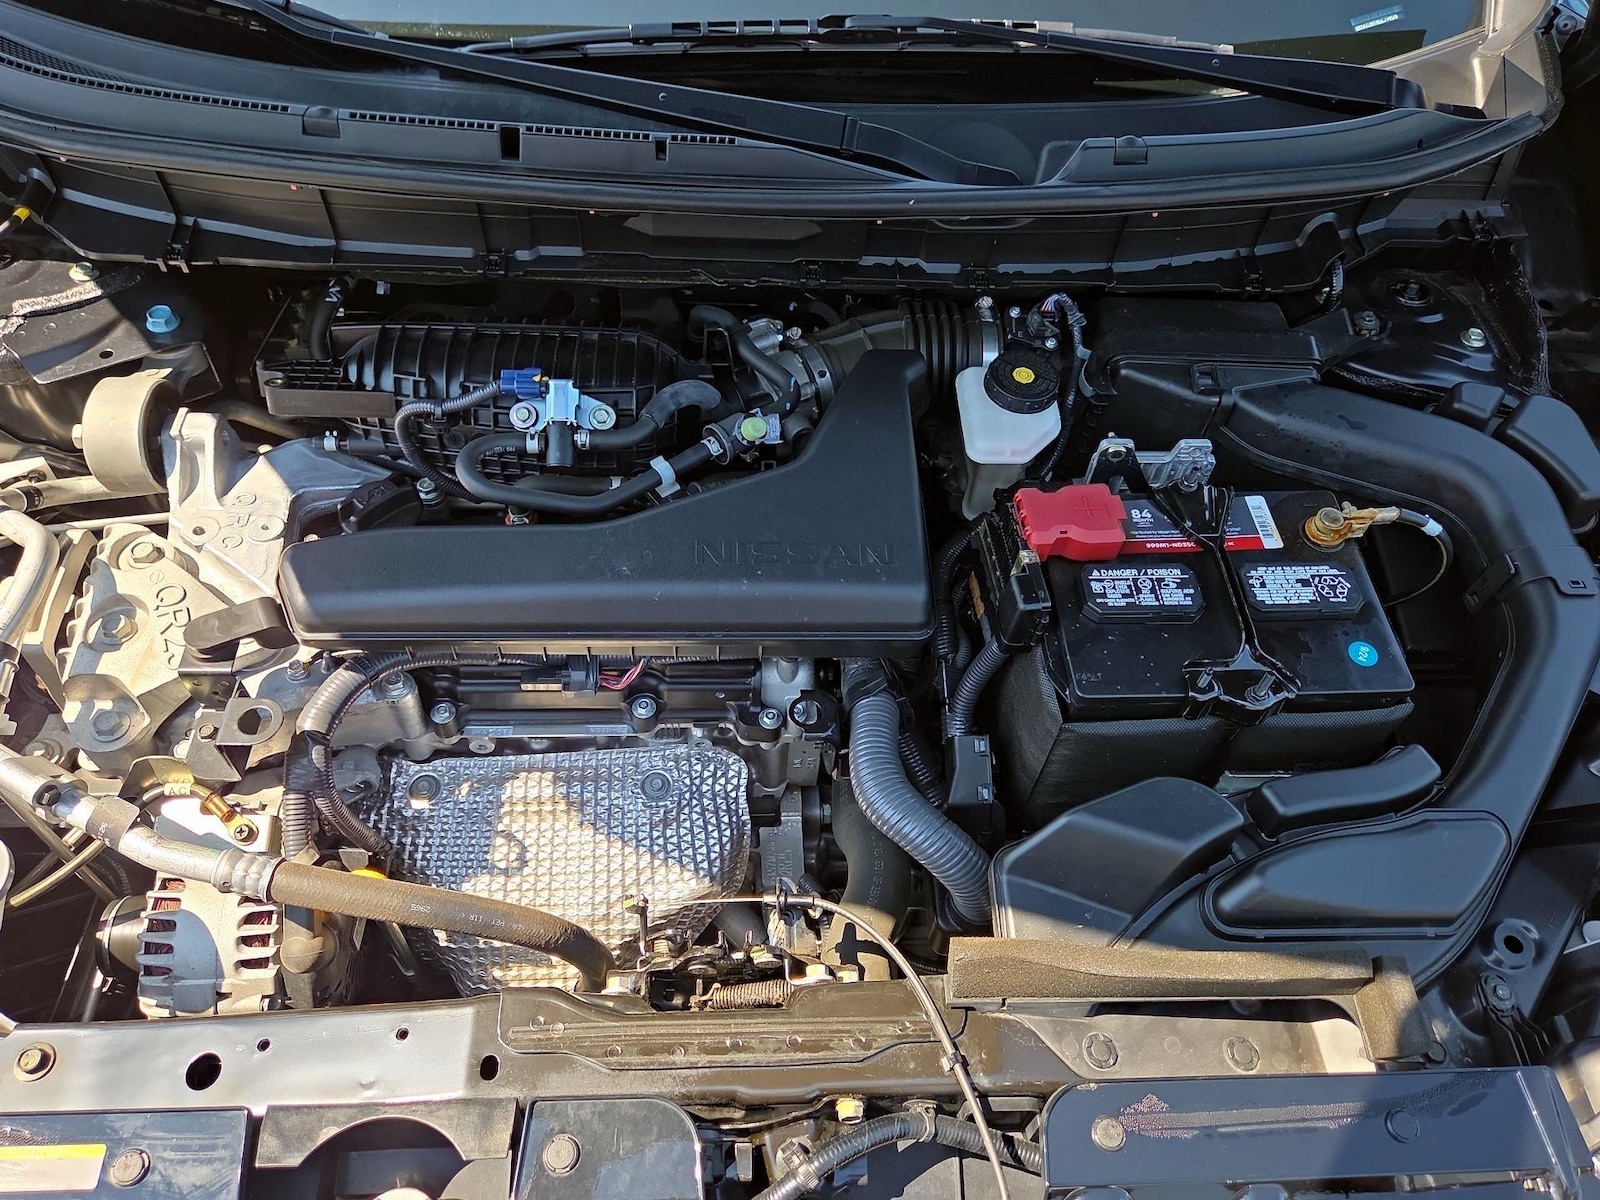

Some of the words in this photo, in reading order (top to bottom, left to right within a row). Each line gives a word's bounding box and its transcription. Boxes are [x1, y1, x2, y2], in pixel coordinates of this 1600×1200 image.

[1130, 509, 1152, 519] 84
[694, 539, 892, 567] NISSAN
[1101, 569, 1138, 577] DANGER
[1147, 568, 1181, 576] POISON
